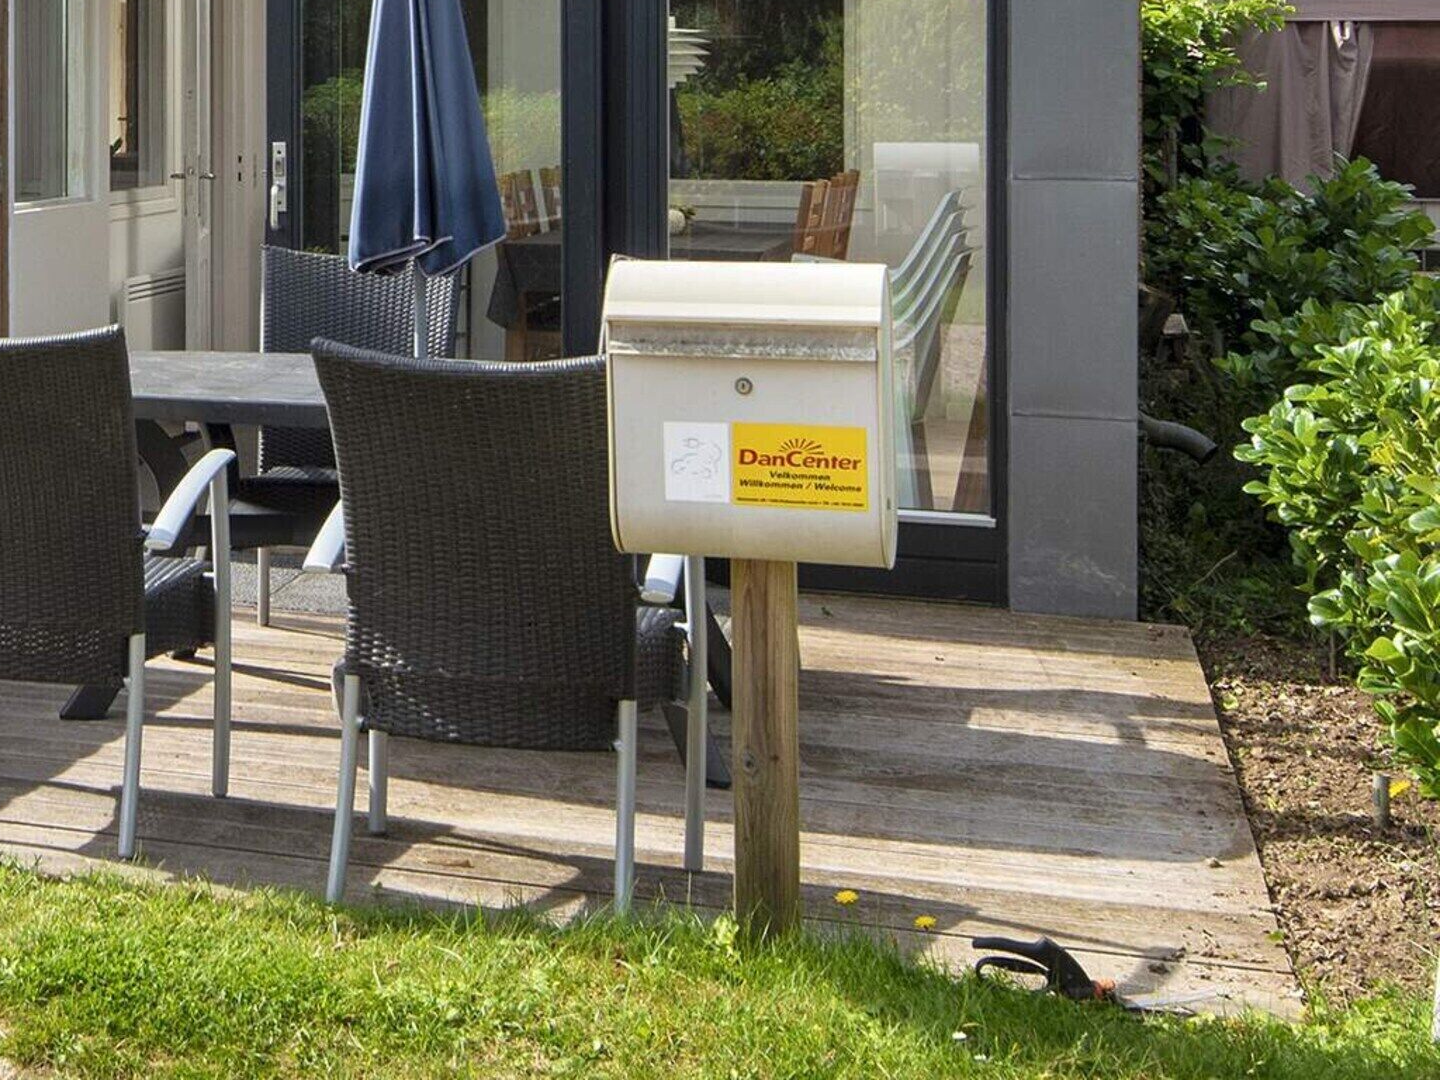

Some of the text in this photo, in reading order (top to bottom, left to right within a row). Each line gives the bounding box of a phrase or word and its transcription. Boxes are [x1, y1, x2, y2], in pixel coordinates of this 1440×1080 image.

[738, 448, 862, 470] DanCenter
[769, 470, 831, 481] Velkommen
[739, 479, 803, 490] Willkommen
[814, 482, 862, 493] Welcome
